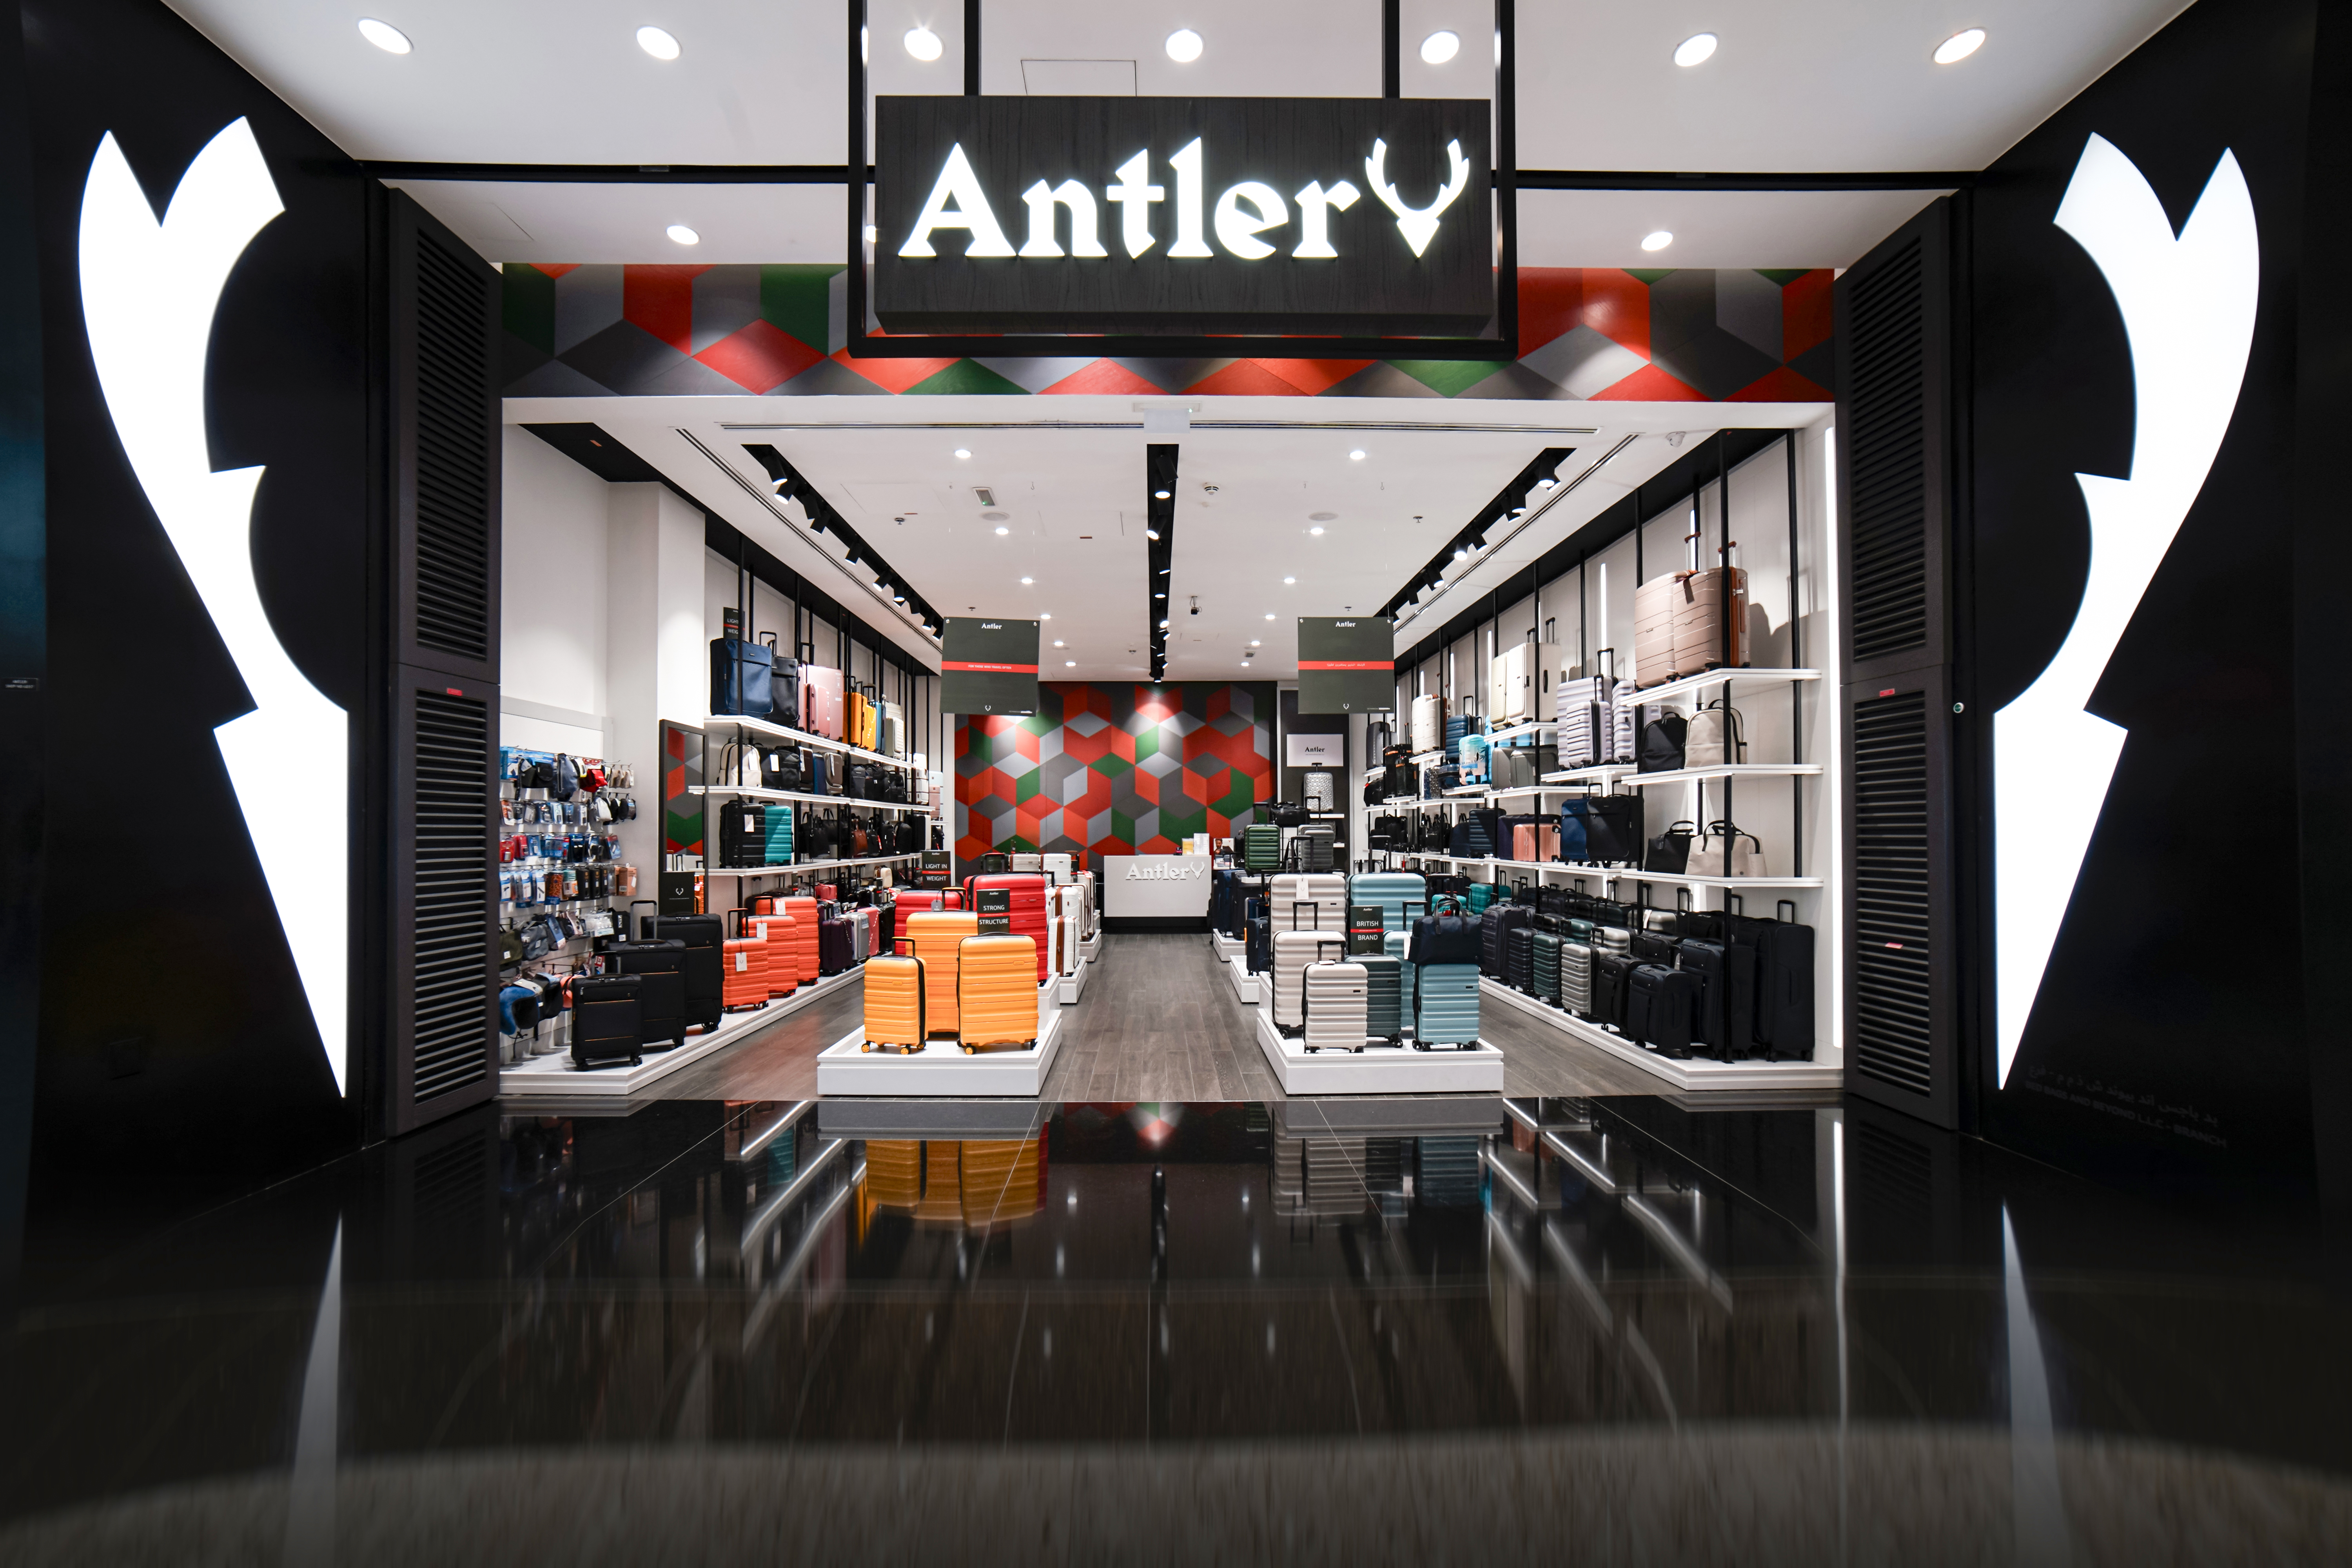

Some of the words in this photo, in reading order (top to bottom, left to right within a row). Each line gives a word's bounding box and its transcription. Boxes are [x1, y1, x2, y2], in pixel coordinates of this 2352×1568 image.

[898, 136, 1361, 260] Antler
[1125, 862, 1190, 880] Antler
[2025, 1080, 2043, 1092] BED
[2043, 1085, 2068, 1100] BAGS
[2069, 1093, 2091, 1106] AND
[2093, 1100, 2135, 1120] BEYOND
[2173, 1124, 2227, 1148] BRANCH
